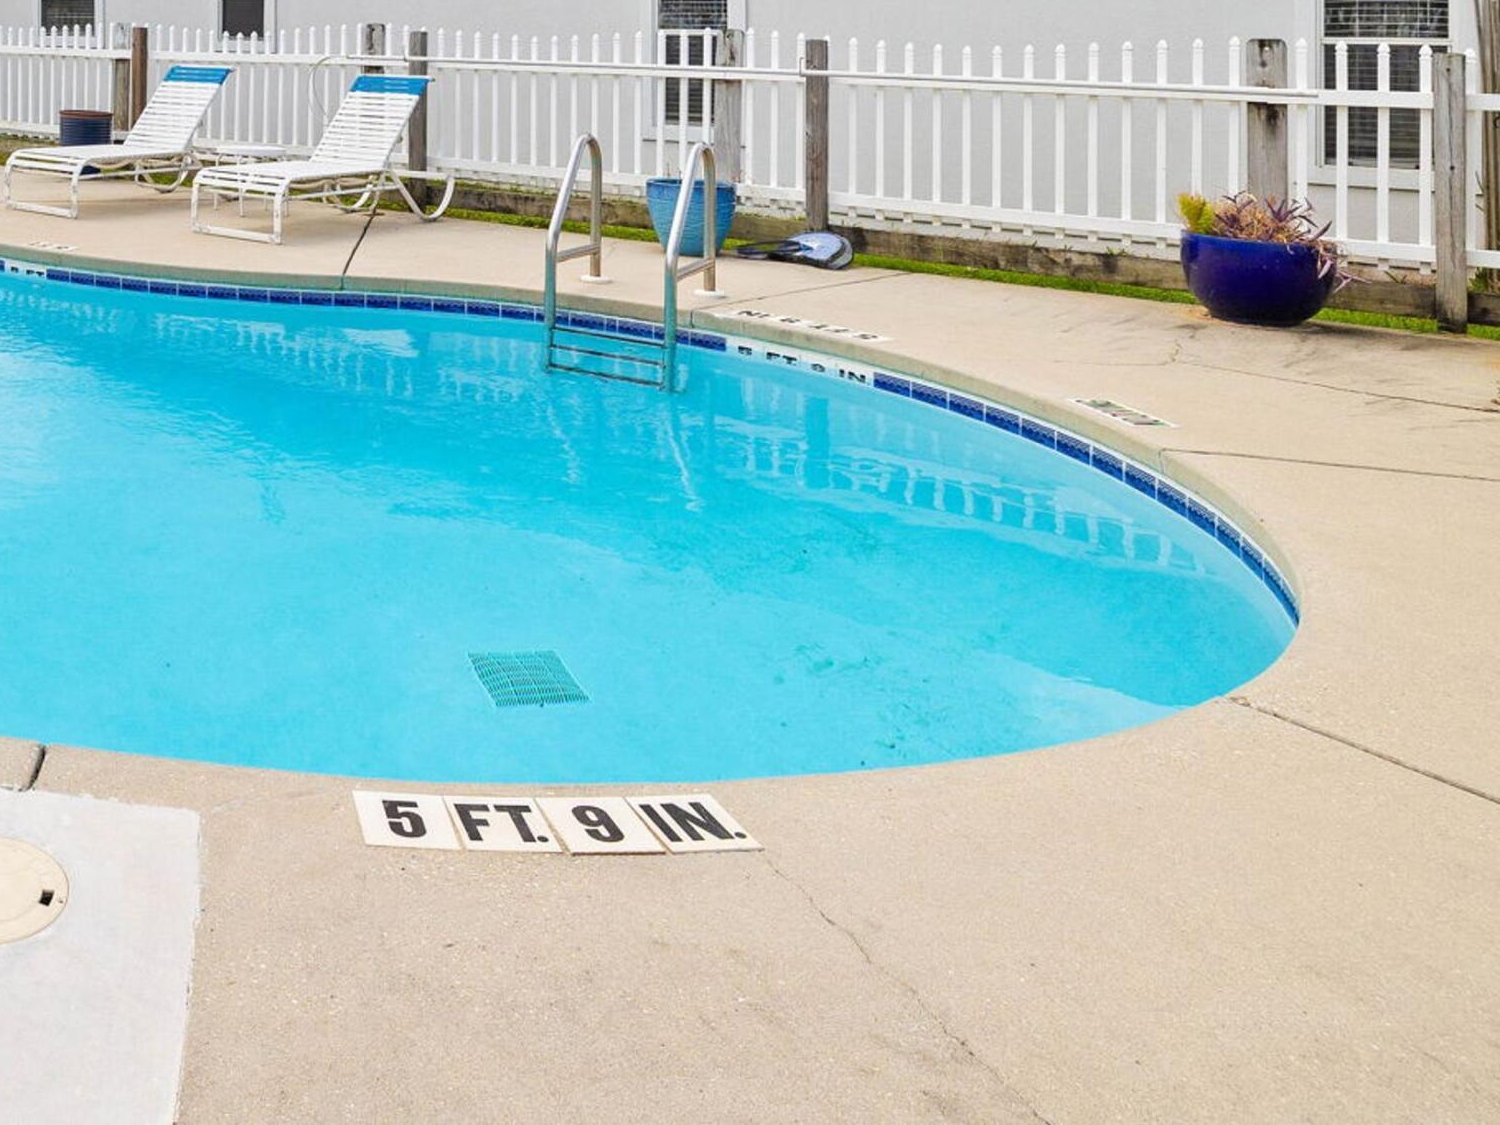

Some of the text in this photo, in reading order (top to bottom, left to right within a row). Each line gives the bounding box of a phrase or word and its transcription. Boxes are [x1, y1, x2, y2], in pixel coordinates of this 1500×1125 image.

[381, 799, 748, 843] 5 FT. 9 IN.
